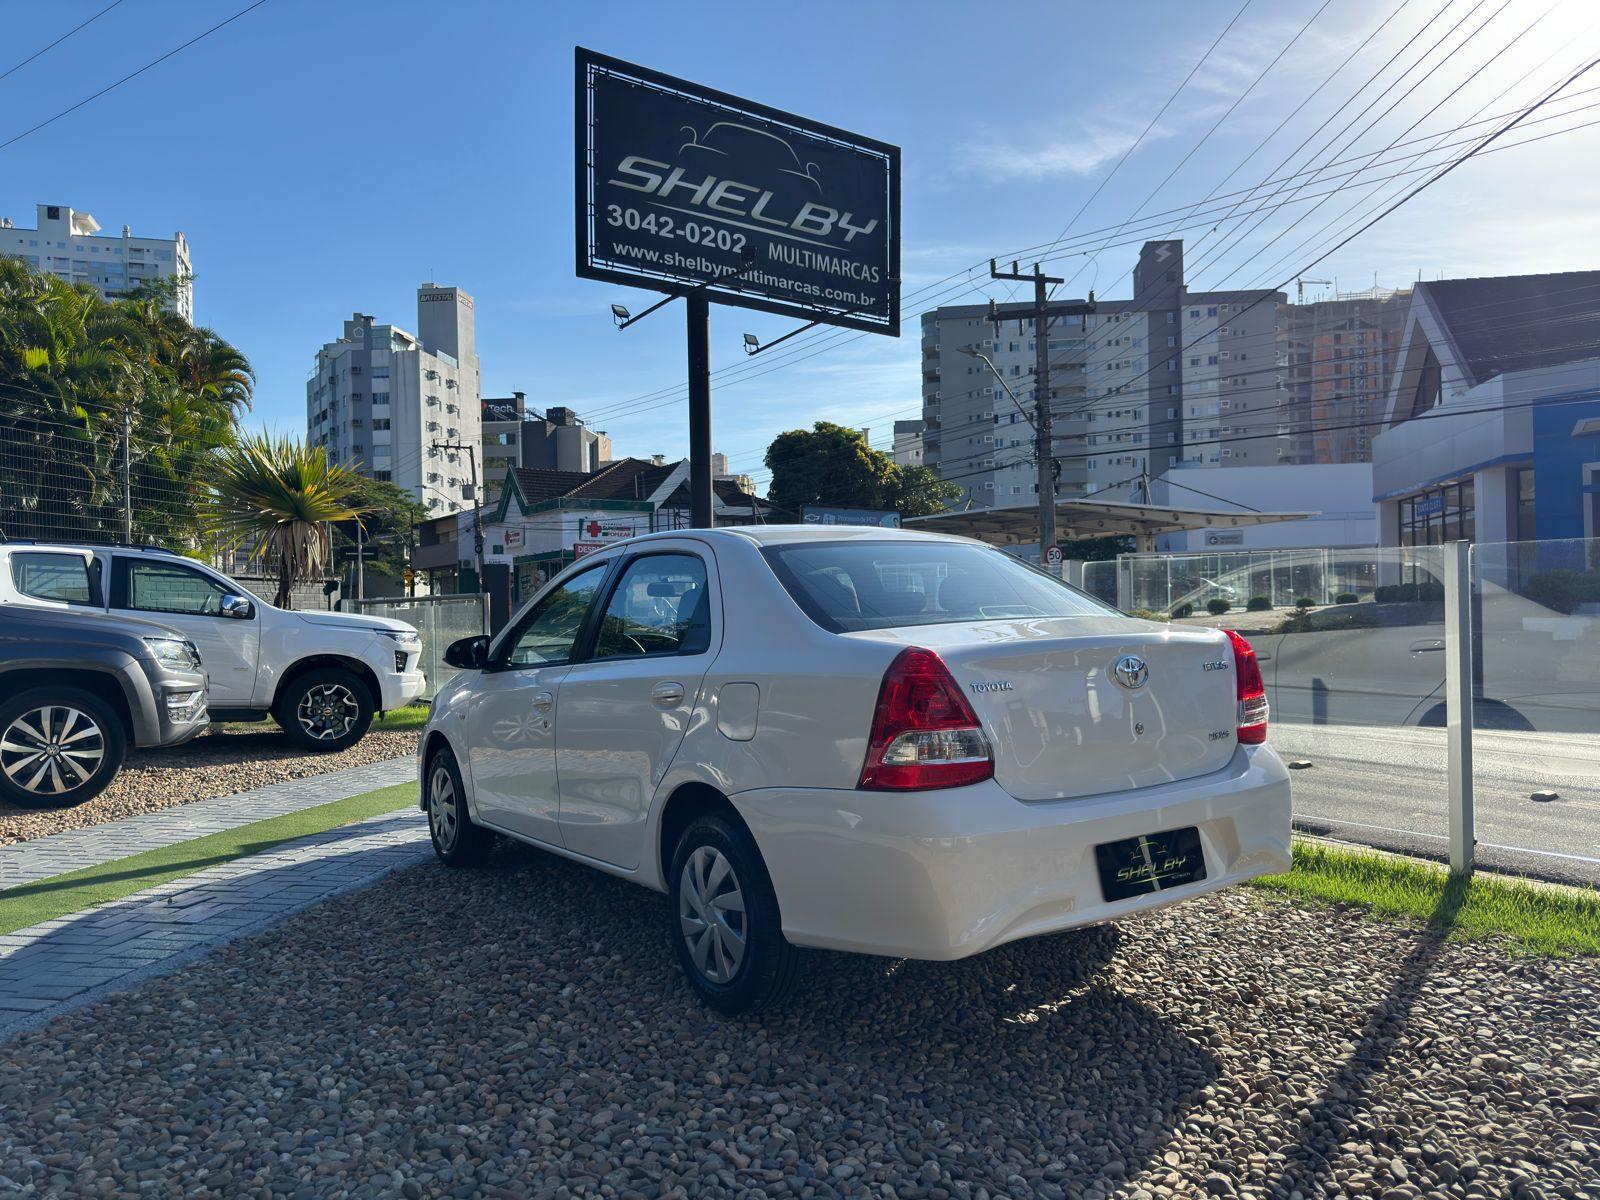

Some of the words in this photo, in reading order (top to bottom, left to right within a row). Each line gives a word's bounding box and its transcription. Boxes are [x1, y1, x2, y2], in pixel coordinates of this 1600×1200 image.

[608, 156, 879, 242] SHELBY
[607, 204, 747, 254] 3042-0202
[768, 242, 880, 283] MULTIMARCAS
[1049, 550, 1061, 560] 50
[970, 681, 1014, 694] TOYOTA
